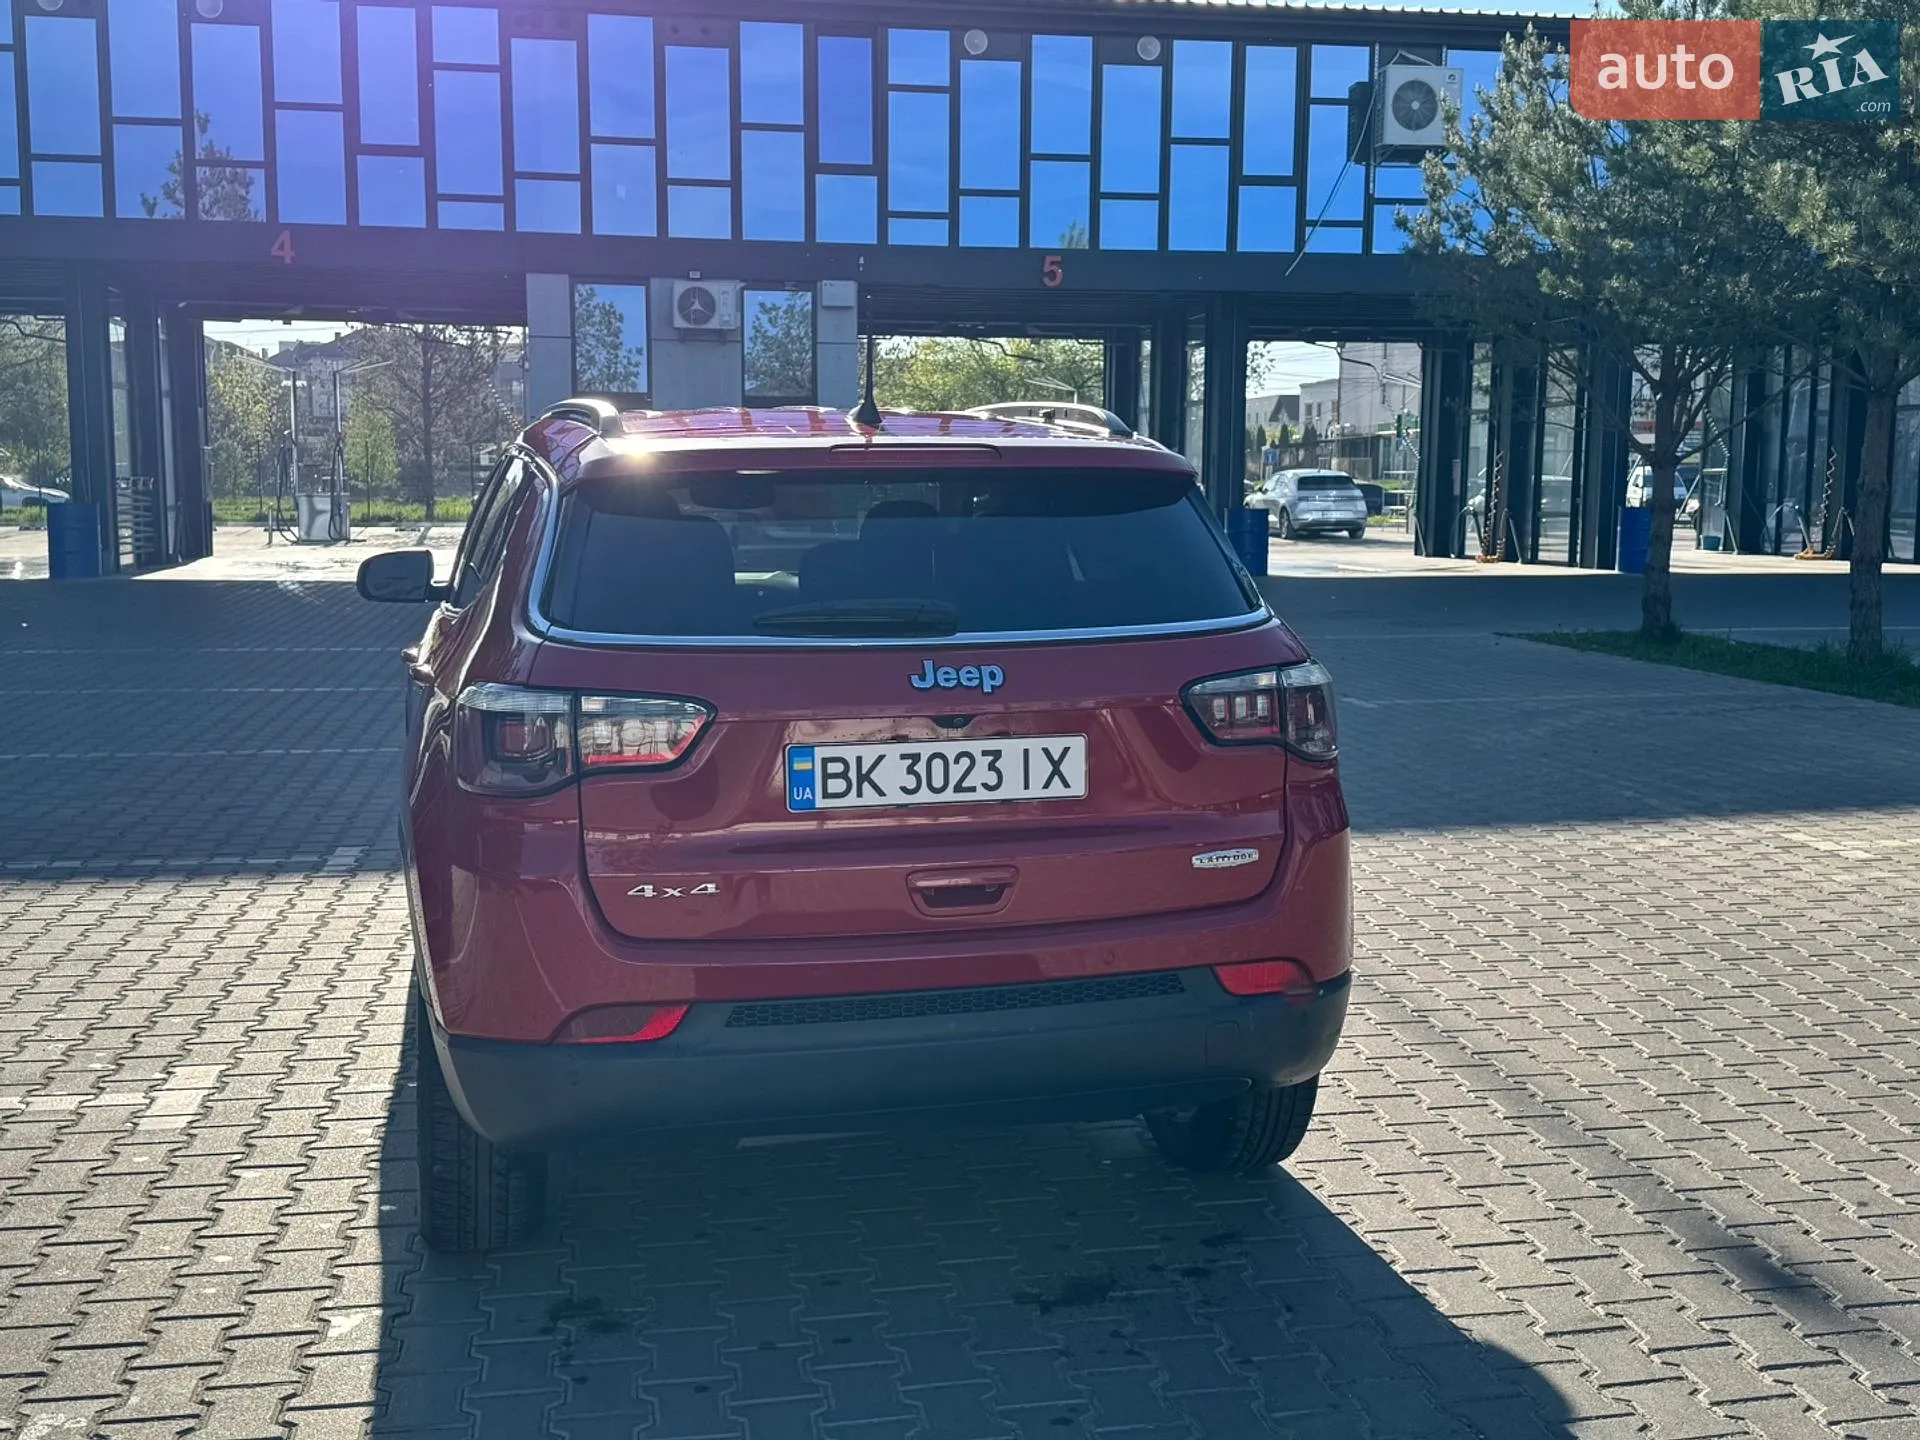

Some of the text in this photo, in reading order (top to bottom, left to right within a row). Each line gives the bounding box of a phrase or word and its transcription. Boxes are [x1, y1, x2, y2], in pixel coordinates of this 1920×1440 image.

[270, 230, 295, 264] 4
[1042, 255, 1063, 287] 5
[909, 659, 1005, 693] Jeep
[820, 746, 1072, 800] BK 3023 IX
[793, 787, 812, 801] UA
